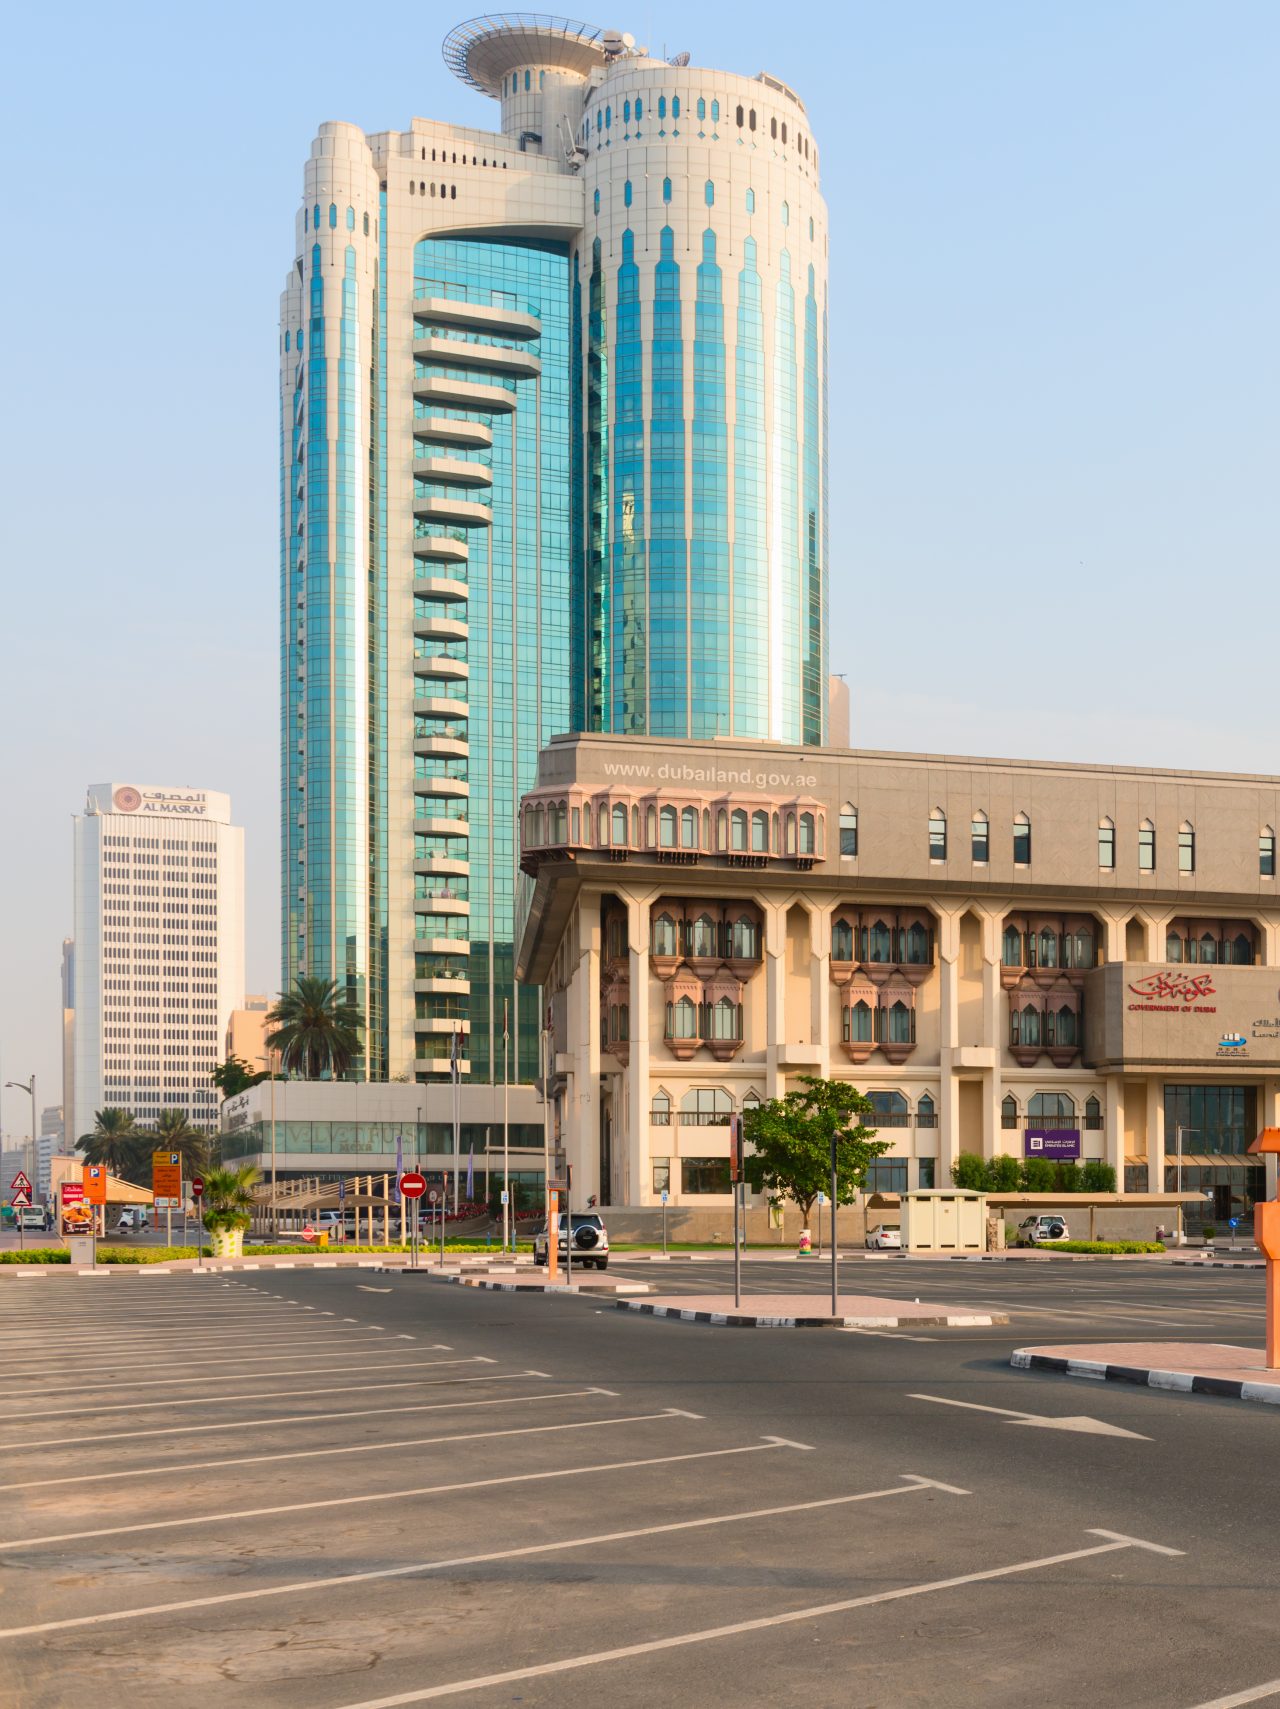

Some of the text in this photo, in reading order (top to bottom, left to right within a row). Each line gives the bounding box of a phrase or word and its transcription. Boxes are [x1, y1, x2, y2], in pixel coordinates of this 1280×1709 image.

[603, 763, 817, 789] www.dubailand.gov.ae
[143, 792, 206, 802] المصرف
[143, 803, 206, 814] AL MASRAF
[1128, 1004, 1180, 1012] GOVERNMENT
[287, 1125, 417, 1144] VELVET FURS
[171, 1154, 178, 1164] P
[90, 1168, 98, 1177] P
